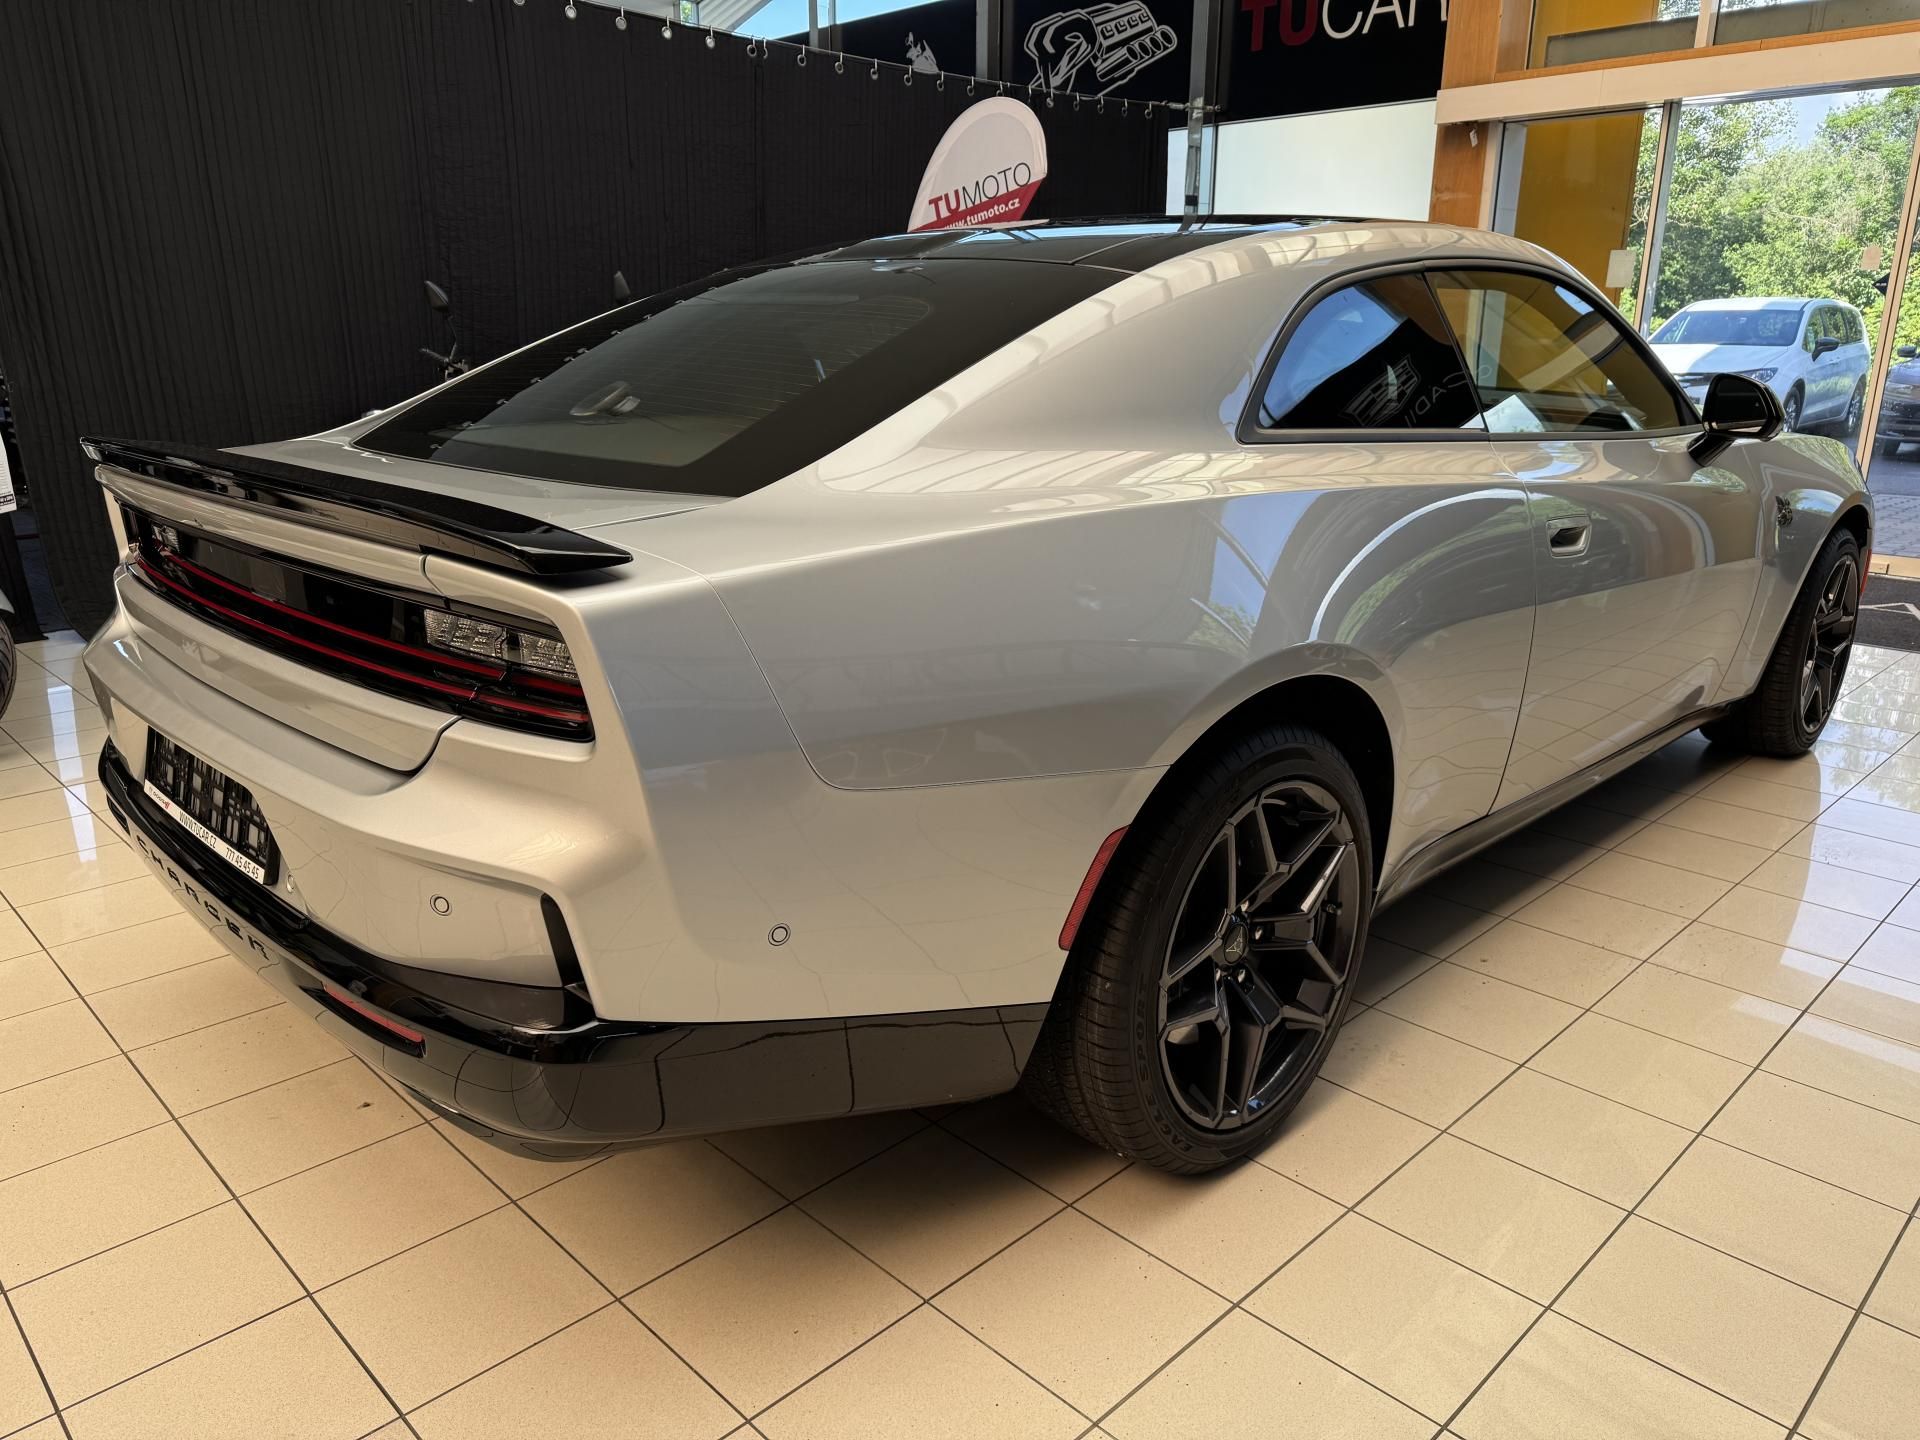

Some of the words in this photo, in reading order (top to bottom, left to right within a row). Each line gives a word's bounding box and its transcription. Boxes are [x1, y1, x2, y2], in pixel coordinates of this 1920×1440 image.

[928, 162, 1031, 221] TUMOTO
[944, 198, 1021, 228] ww.tumoto.cz
[235, 855, 243, 869] 45
[243, 861, 251, 874] 45
[251, 867, 259, 880] 45
[136, 835, 270, 961] CHARGER
